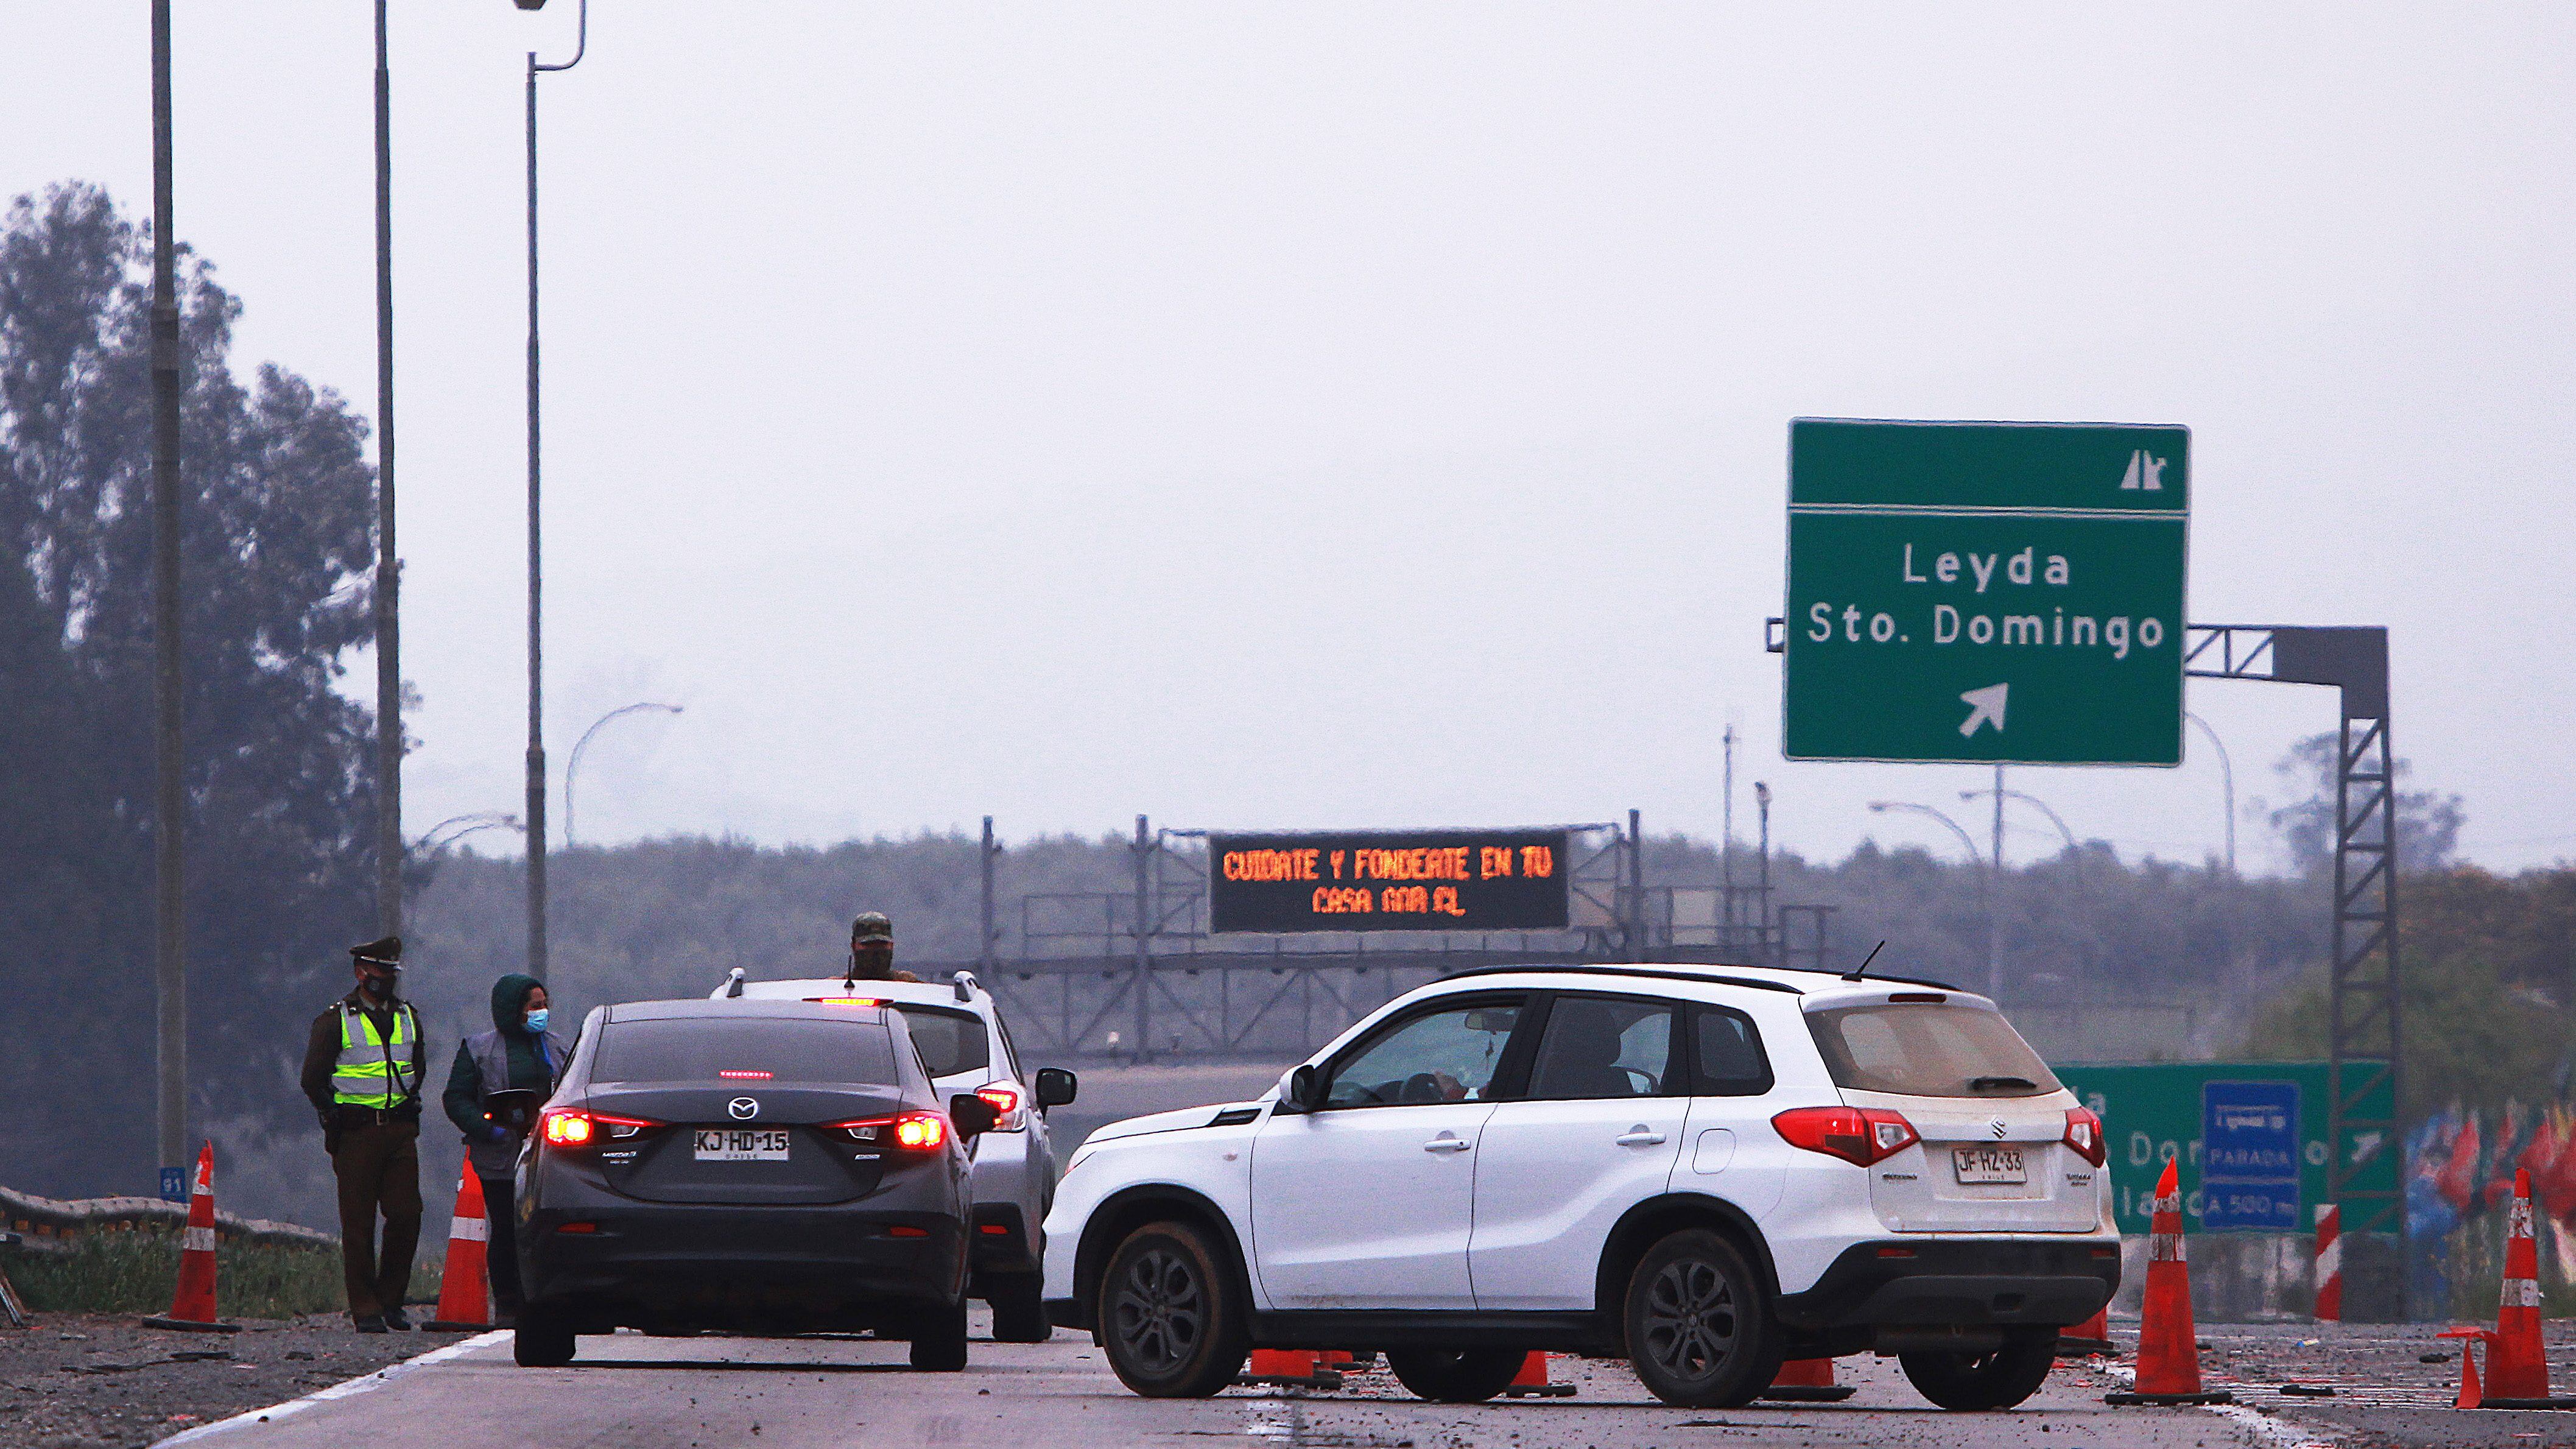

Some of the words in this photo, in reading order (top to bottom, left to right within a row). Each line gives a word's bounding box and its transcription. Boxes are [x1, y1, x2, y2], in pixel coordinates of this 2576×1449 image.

[1903, 543, 2069, 593] Leyda
[1807, 602, 1909, 643] Sto.
[1934, 604, 2164, 659] Domingo
[1330, 849, 1345, 880] Y
[1480, 845, 1513, 881] EN
[1519, 845, 1552, 878] TU
[2206, 1196, 2222, 1214] A
[2229, 1194, 2272, 1215] 500
